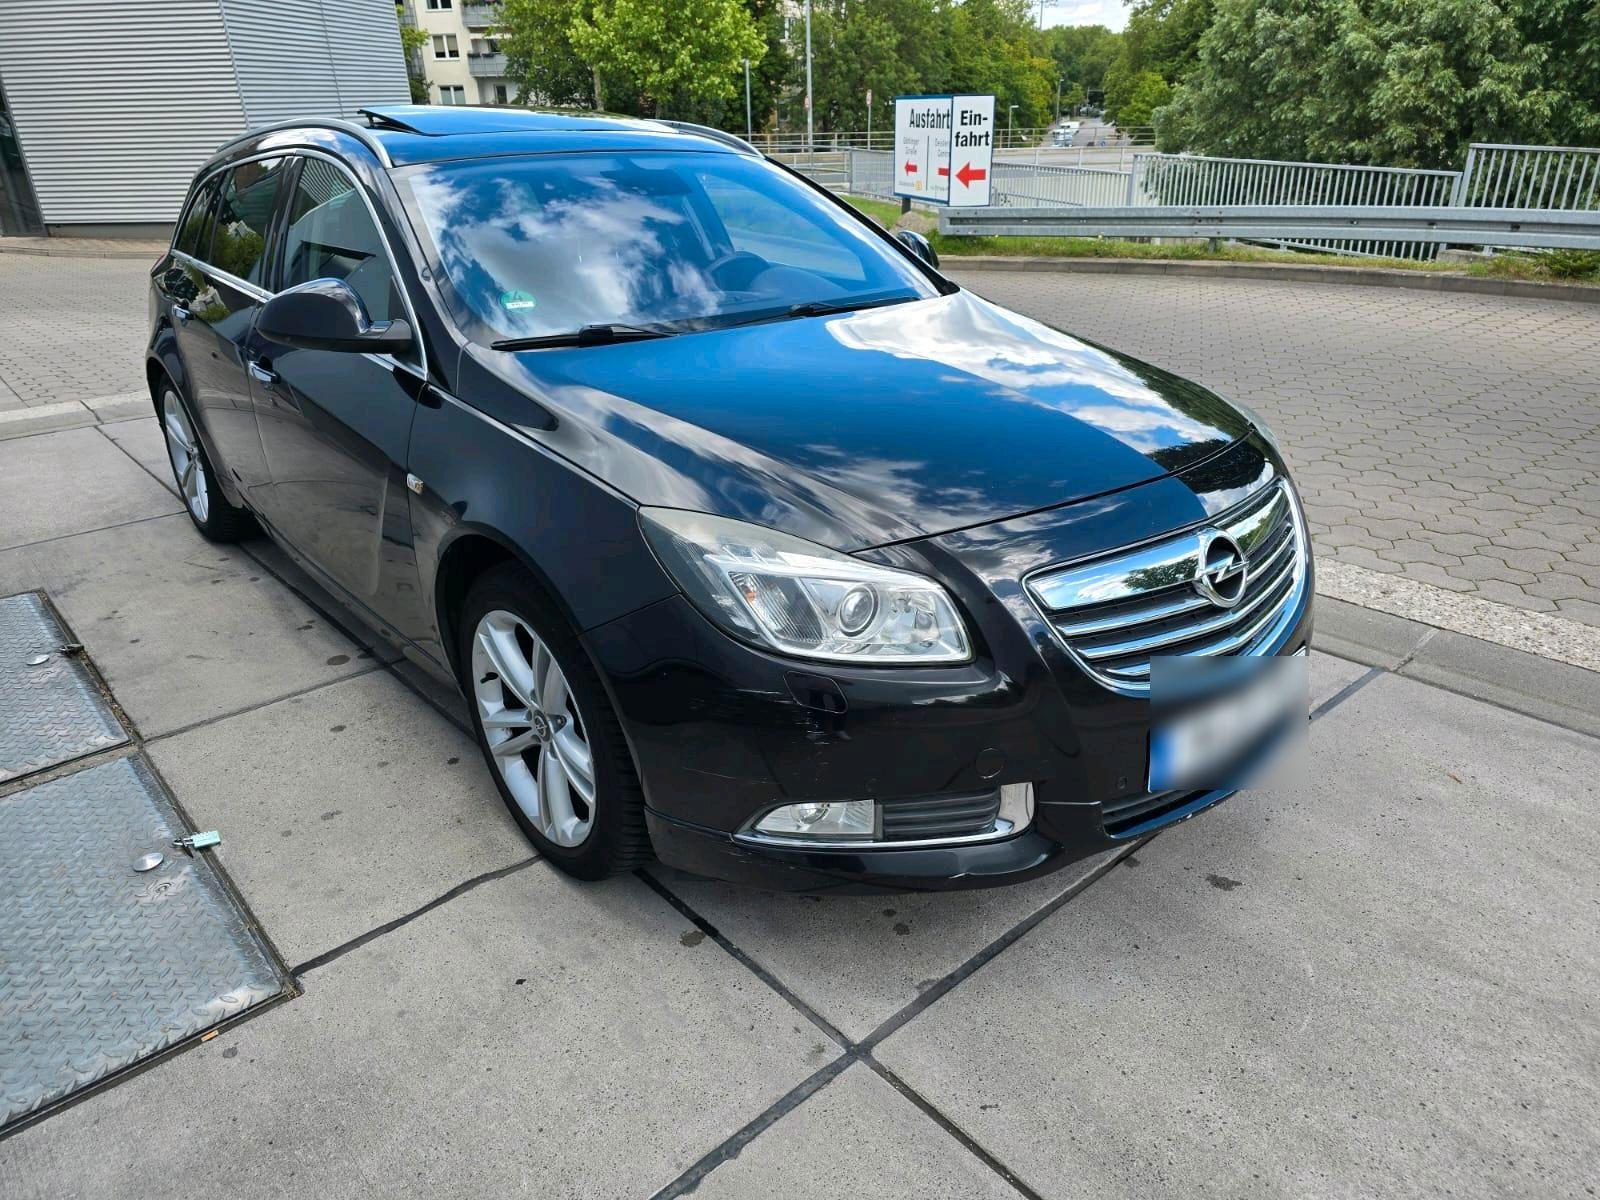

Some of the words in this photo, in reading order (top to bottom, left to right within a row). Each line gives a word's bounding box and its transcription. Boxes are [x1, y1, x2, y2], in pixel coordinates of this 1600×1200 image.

[909, 108, 950, 129] Ausfahrt
[960, 110, 988, 126] Ein-
[955, 131, 990, 147] fahrt
